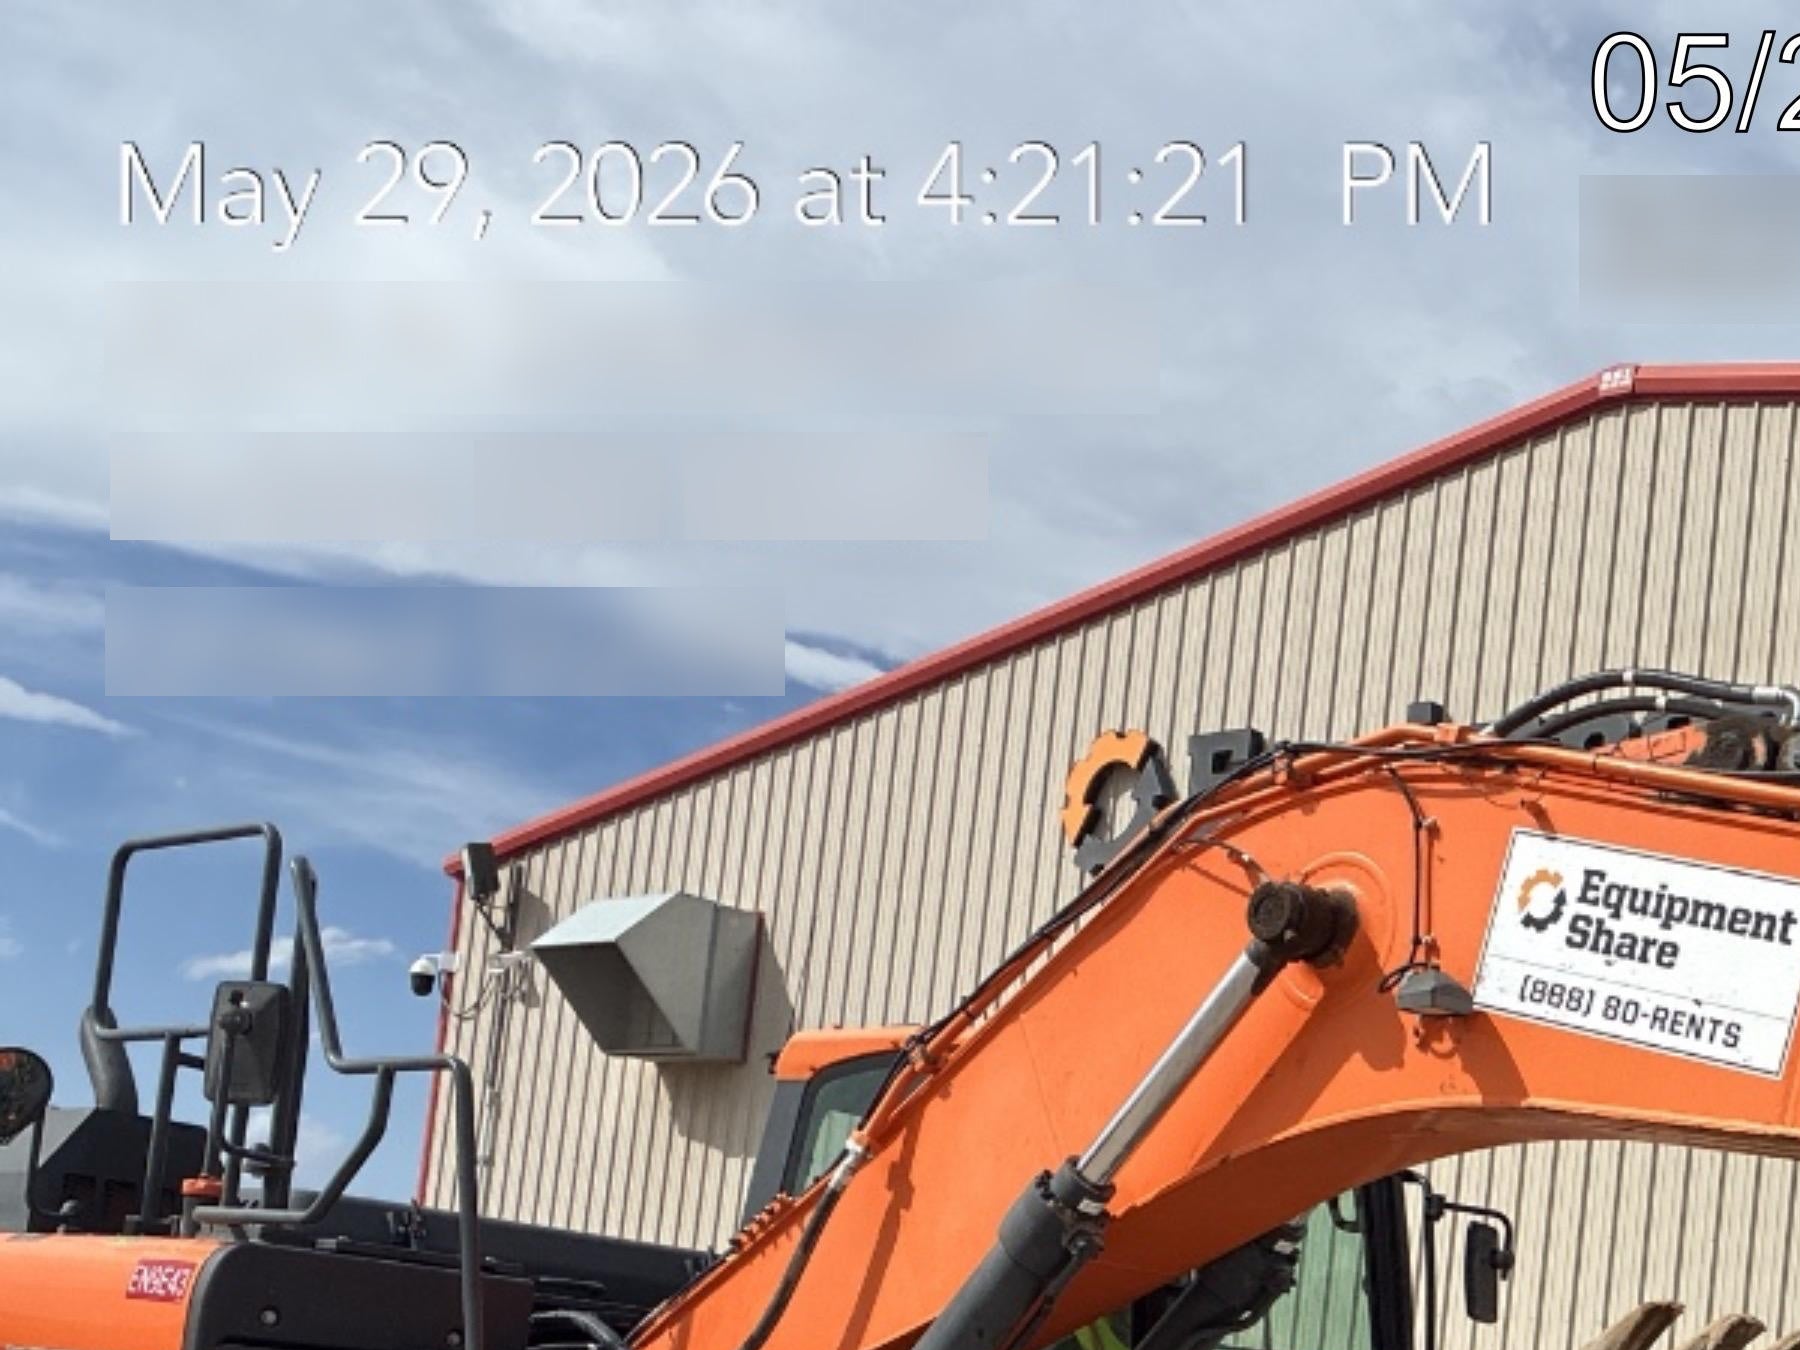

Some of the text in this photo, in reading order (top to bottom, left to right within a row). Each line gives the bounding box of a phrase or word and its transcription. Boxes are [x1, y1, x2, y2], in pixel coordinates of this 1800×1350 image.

[1565, 914, 1681, 970] Share
[1577, 868, 1799, 946] Equipment
[1519, 973, 1743, 1050] (888) 80-RENTS
